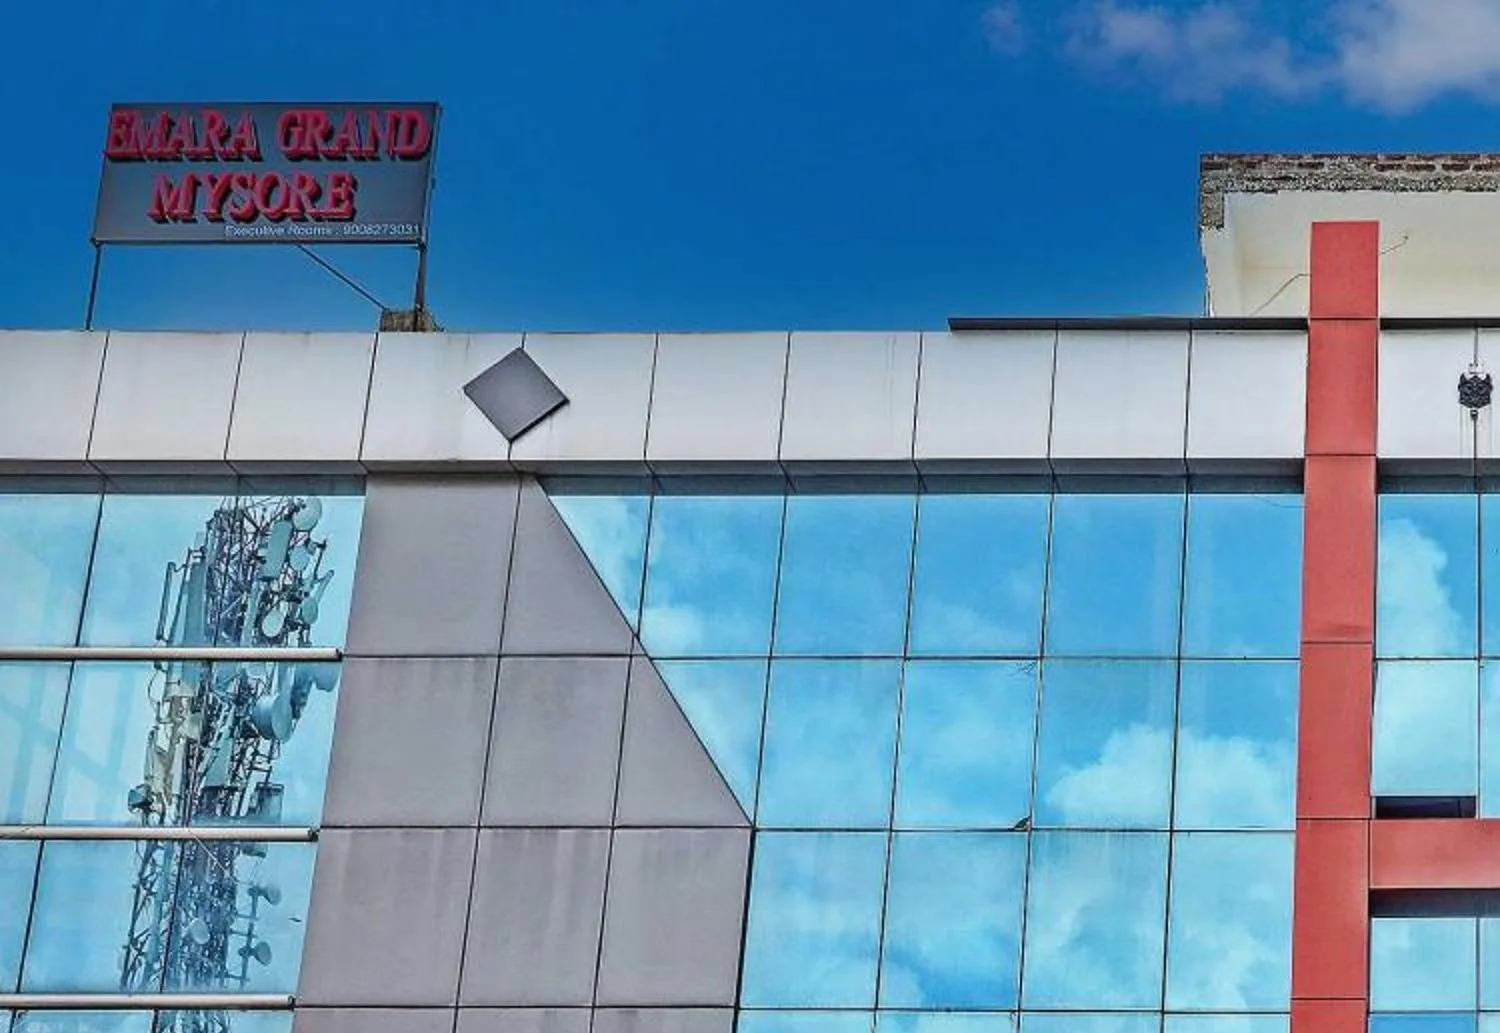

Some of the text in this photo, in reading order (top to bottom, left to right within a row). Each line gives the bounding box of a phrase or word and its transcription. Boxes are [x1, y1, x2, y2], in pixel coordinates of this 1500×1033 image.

[104, 107, 431, 160] EMARA GRAND
[148, 171, 357, 221] MYSORE
[224, 225, 284, 236] Executive
[287, 225, 332, 236] Rooms
